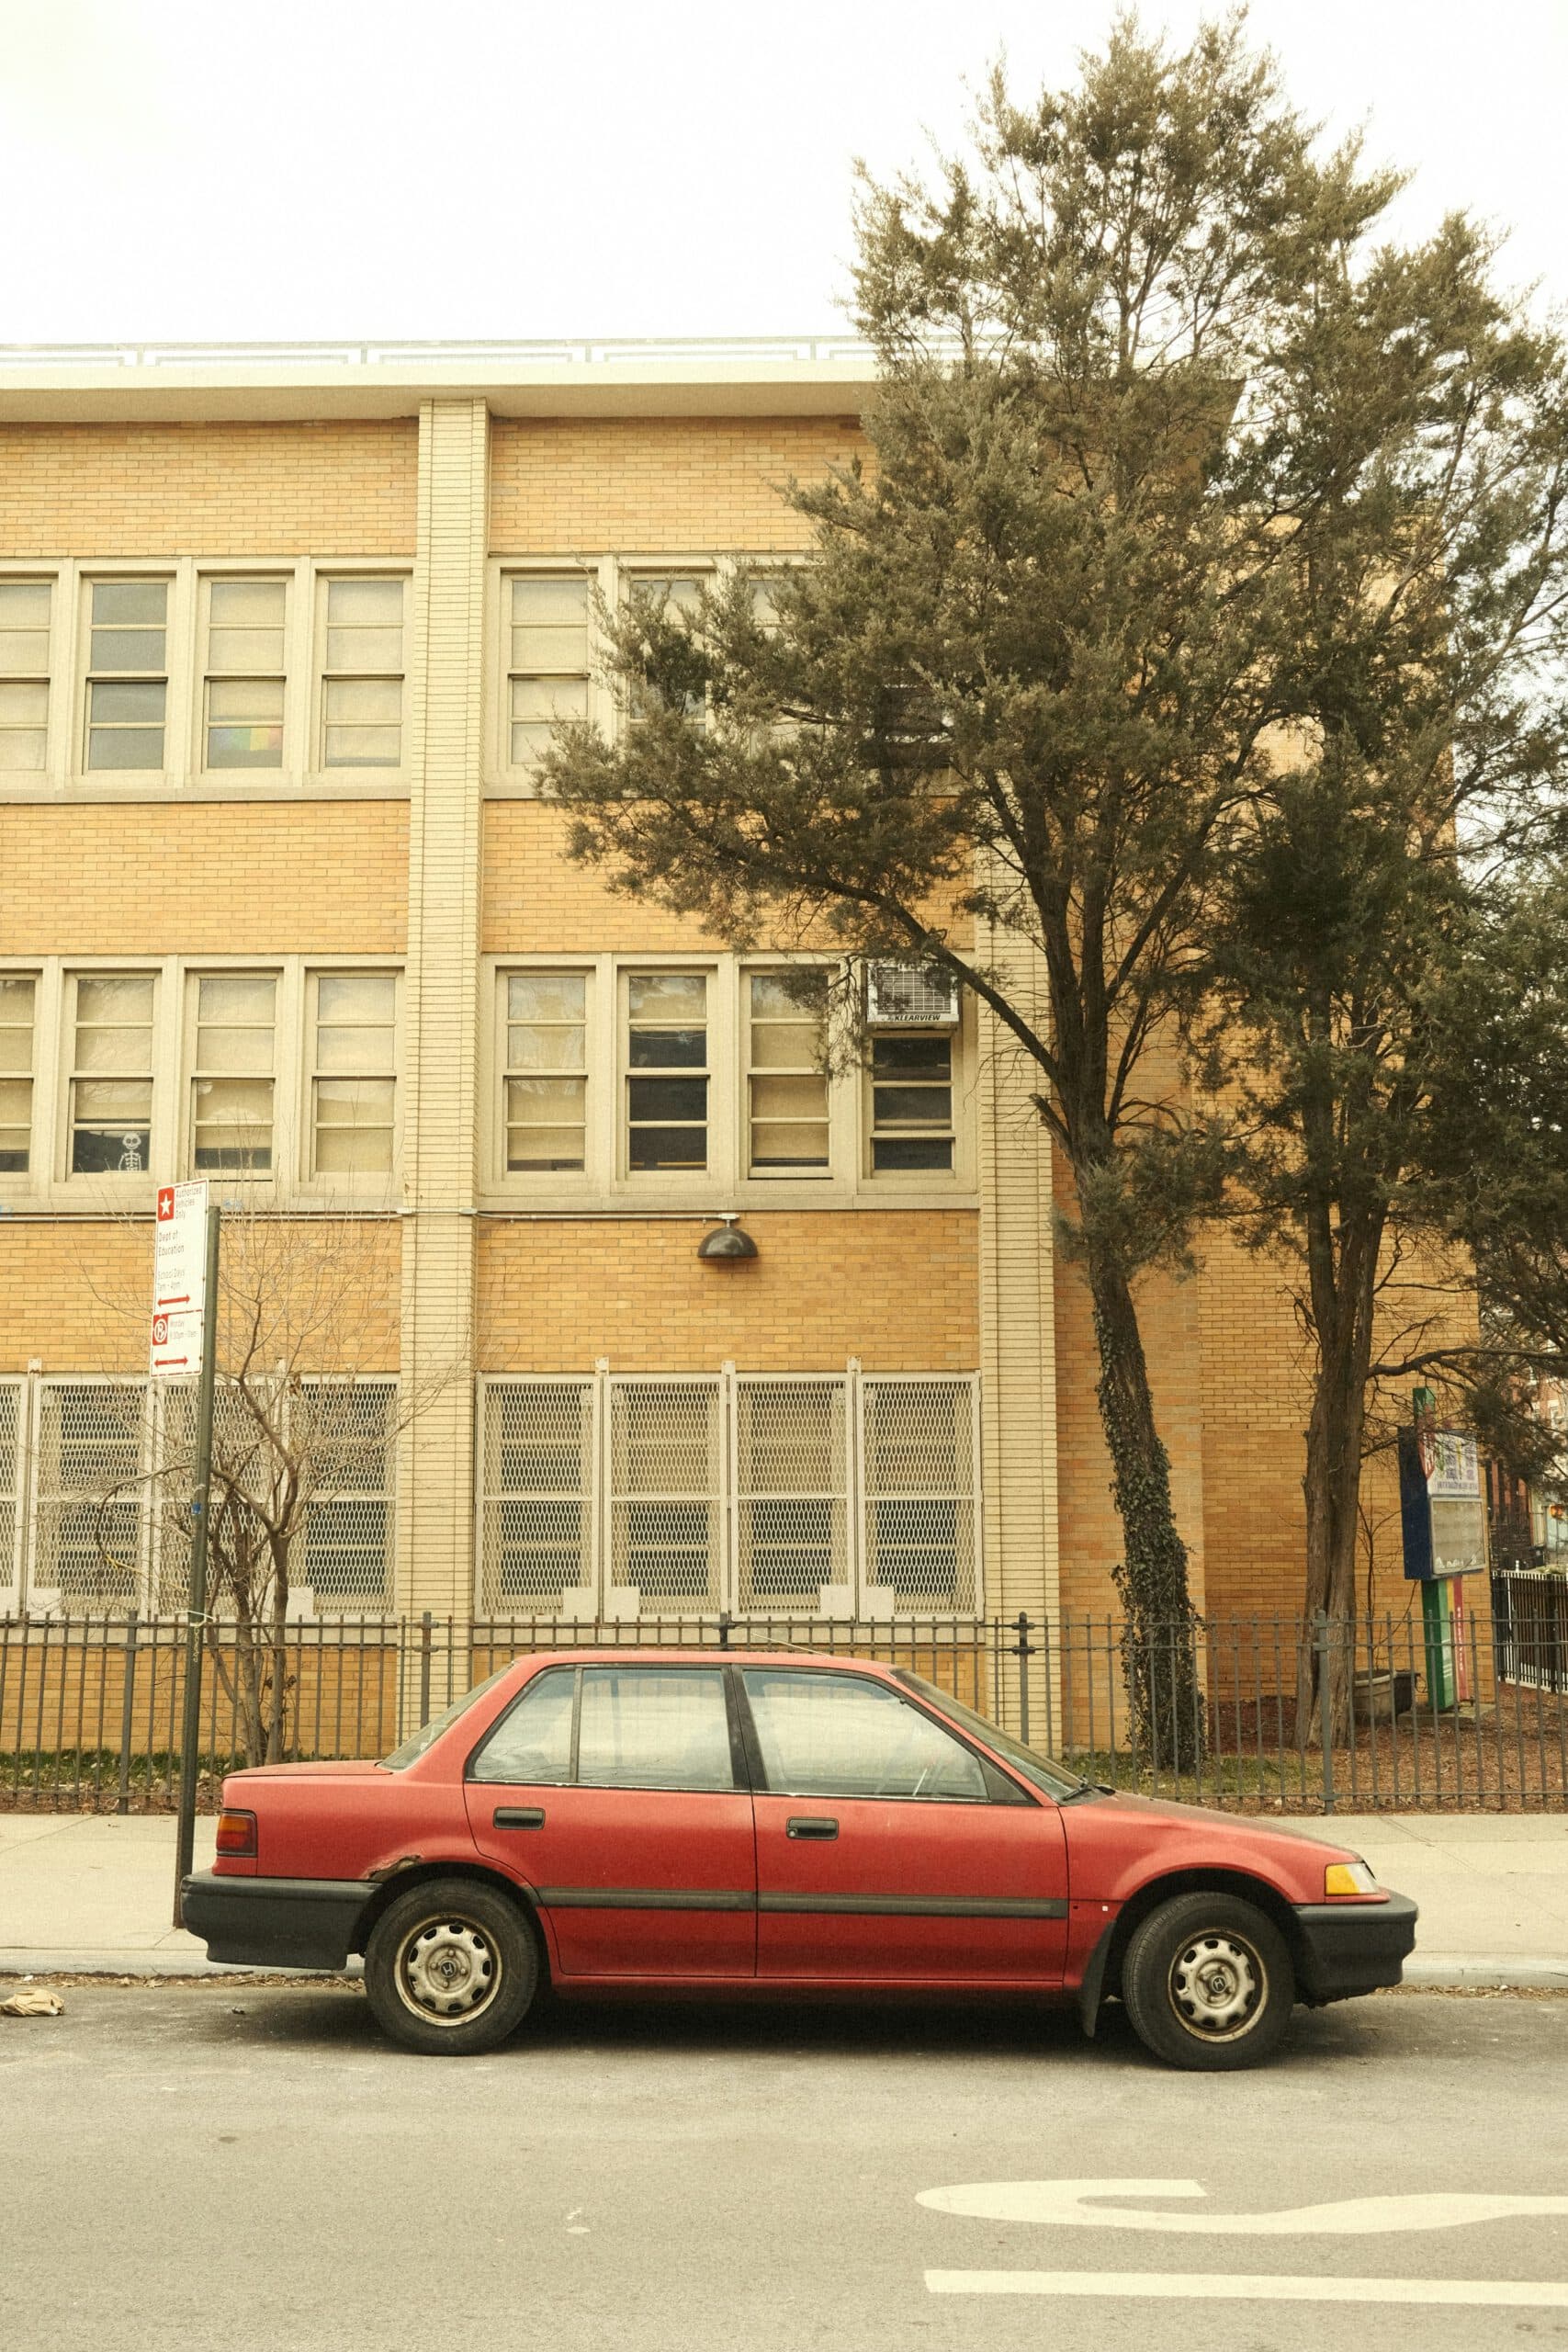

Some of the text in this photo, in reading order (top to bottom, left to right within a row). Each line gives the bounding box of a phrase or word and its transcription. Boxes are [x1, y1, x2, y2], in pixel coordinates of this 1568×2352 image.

[175, 1185, 202, 1198] Authorized
[175, 1198, 195, 1209] Vehicles
[175, 1210, 186, 1220] Only
[158, 1229, 178, 1243] Dept of
[158, 1244, 184, 1257] Education
[157, 1270, 172, 1280] School
